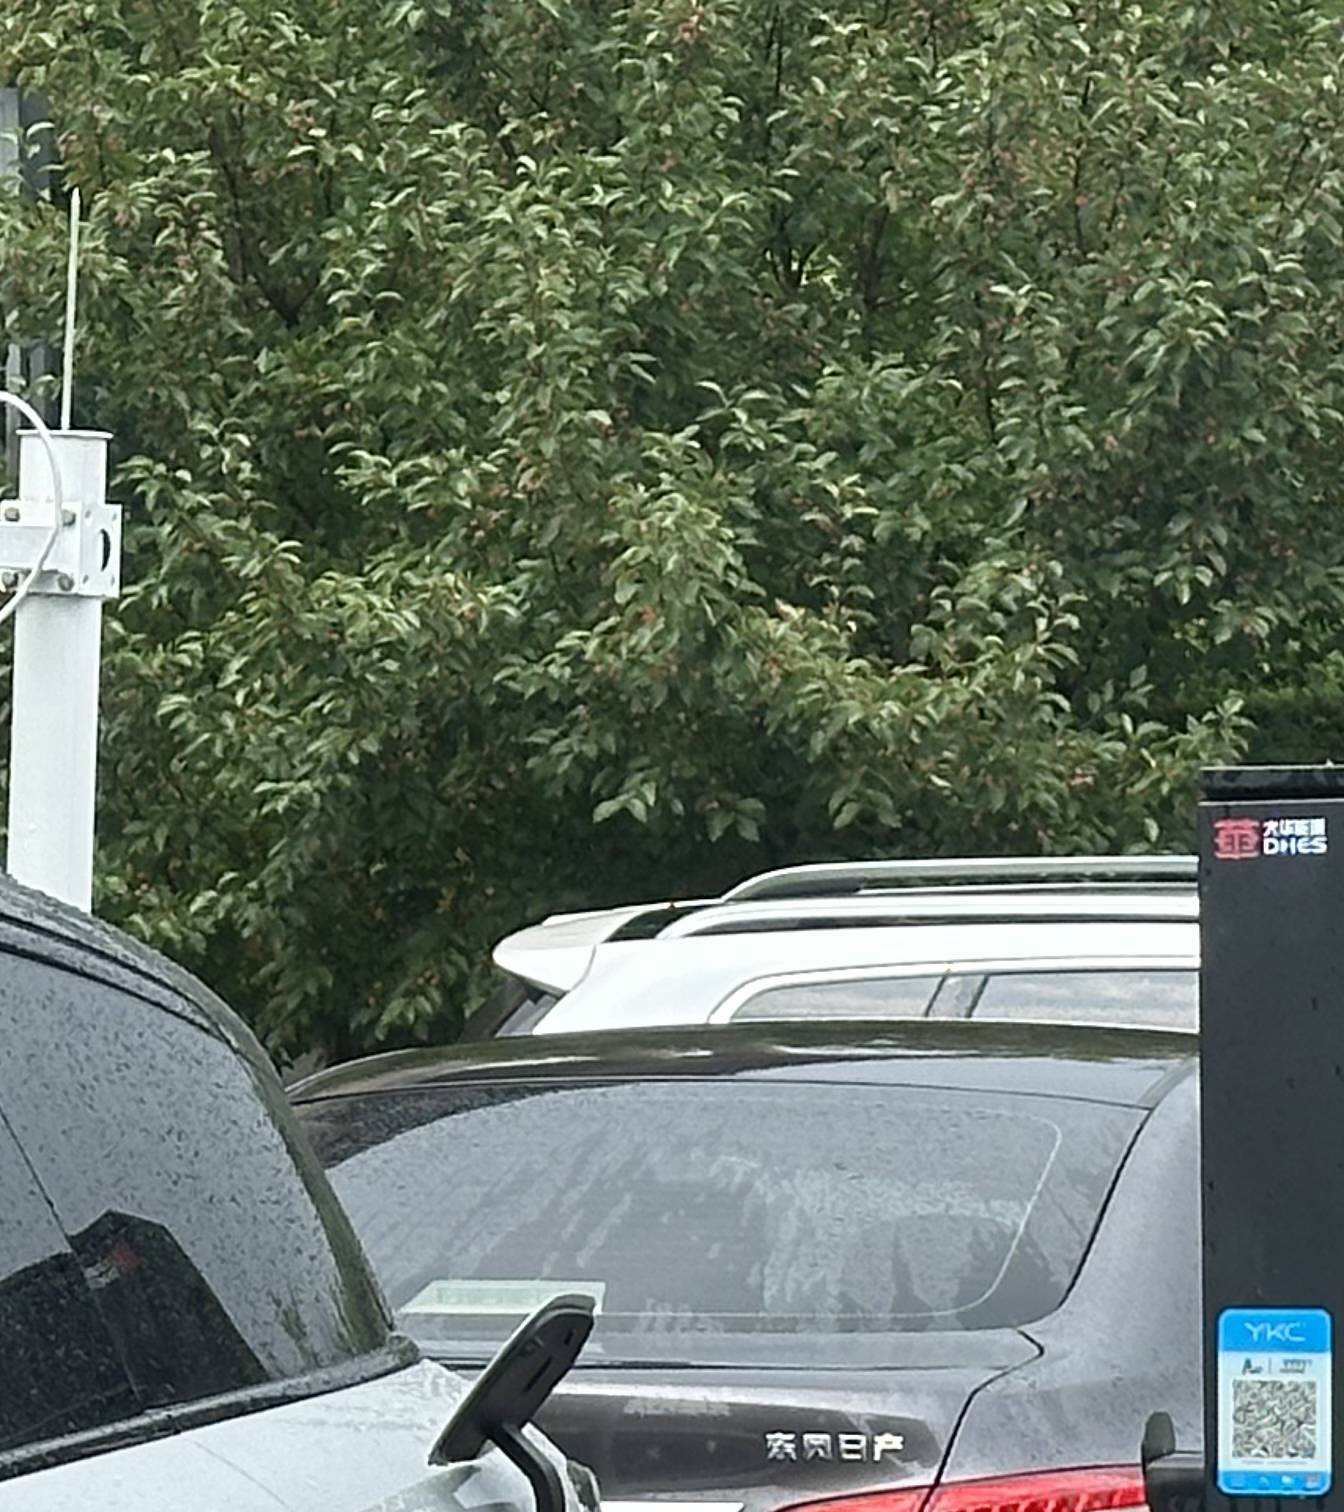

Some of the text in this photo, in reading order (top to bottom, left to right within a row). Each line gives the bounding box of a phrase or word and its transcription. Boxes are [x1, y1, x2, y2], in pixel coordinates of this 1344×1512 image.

[1244, 1322, 1306, 1342] YKC
[765, 1432, 904, 1462] 东风日产
